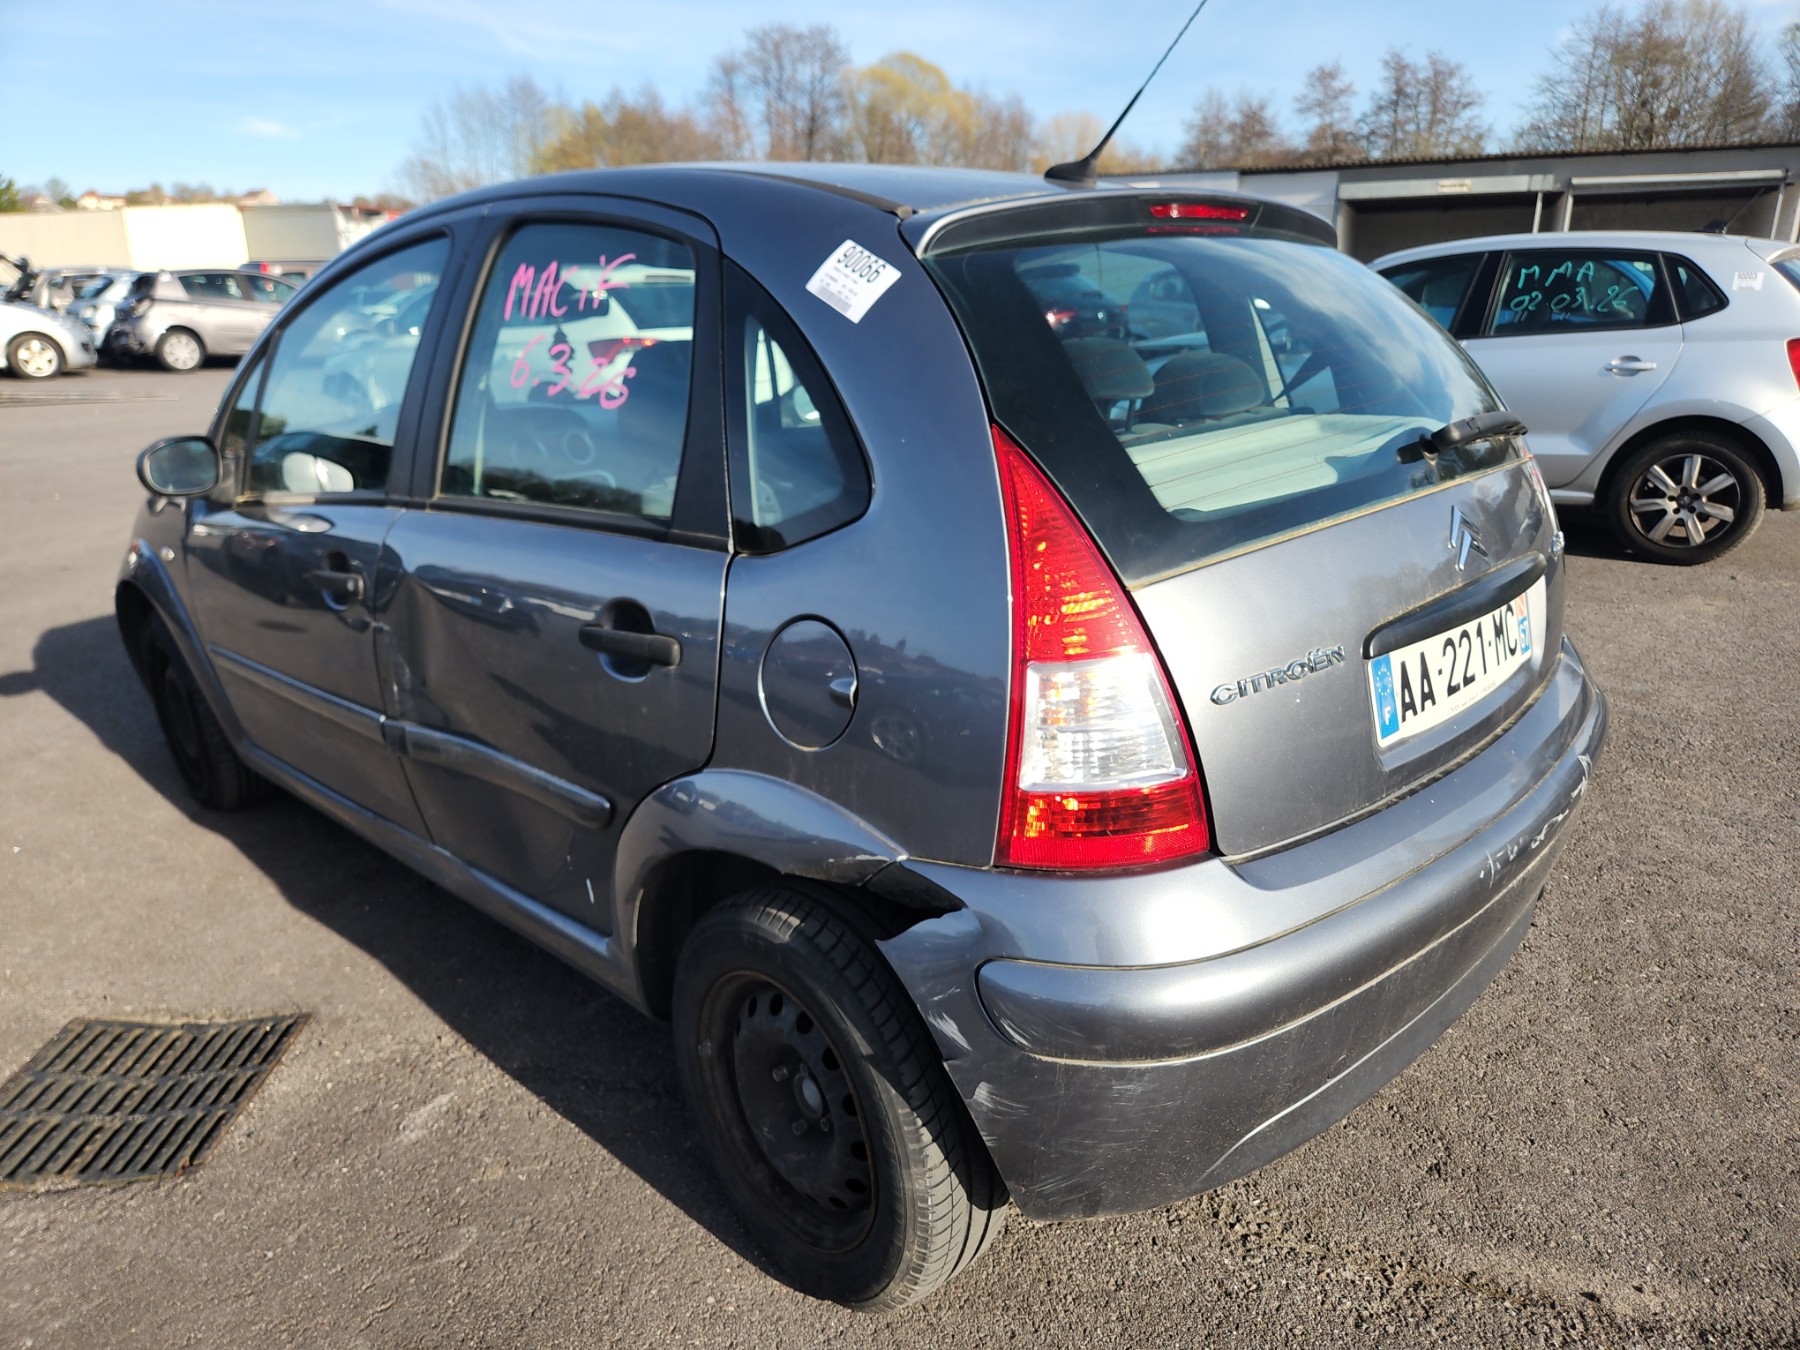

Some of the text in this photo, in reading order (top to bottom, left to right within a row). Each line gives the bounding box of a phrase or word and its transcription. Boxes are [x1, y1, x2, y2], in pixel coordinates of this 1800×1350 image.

[837, 246, 886, 283] 90066
[1401, 603, 1518, 723] AA-221-MC
[1383, 706, 1392, 726] F
